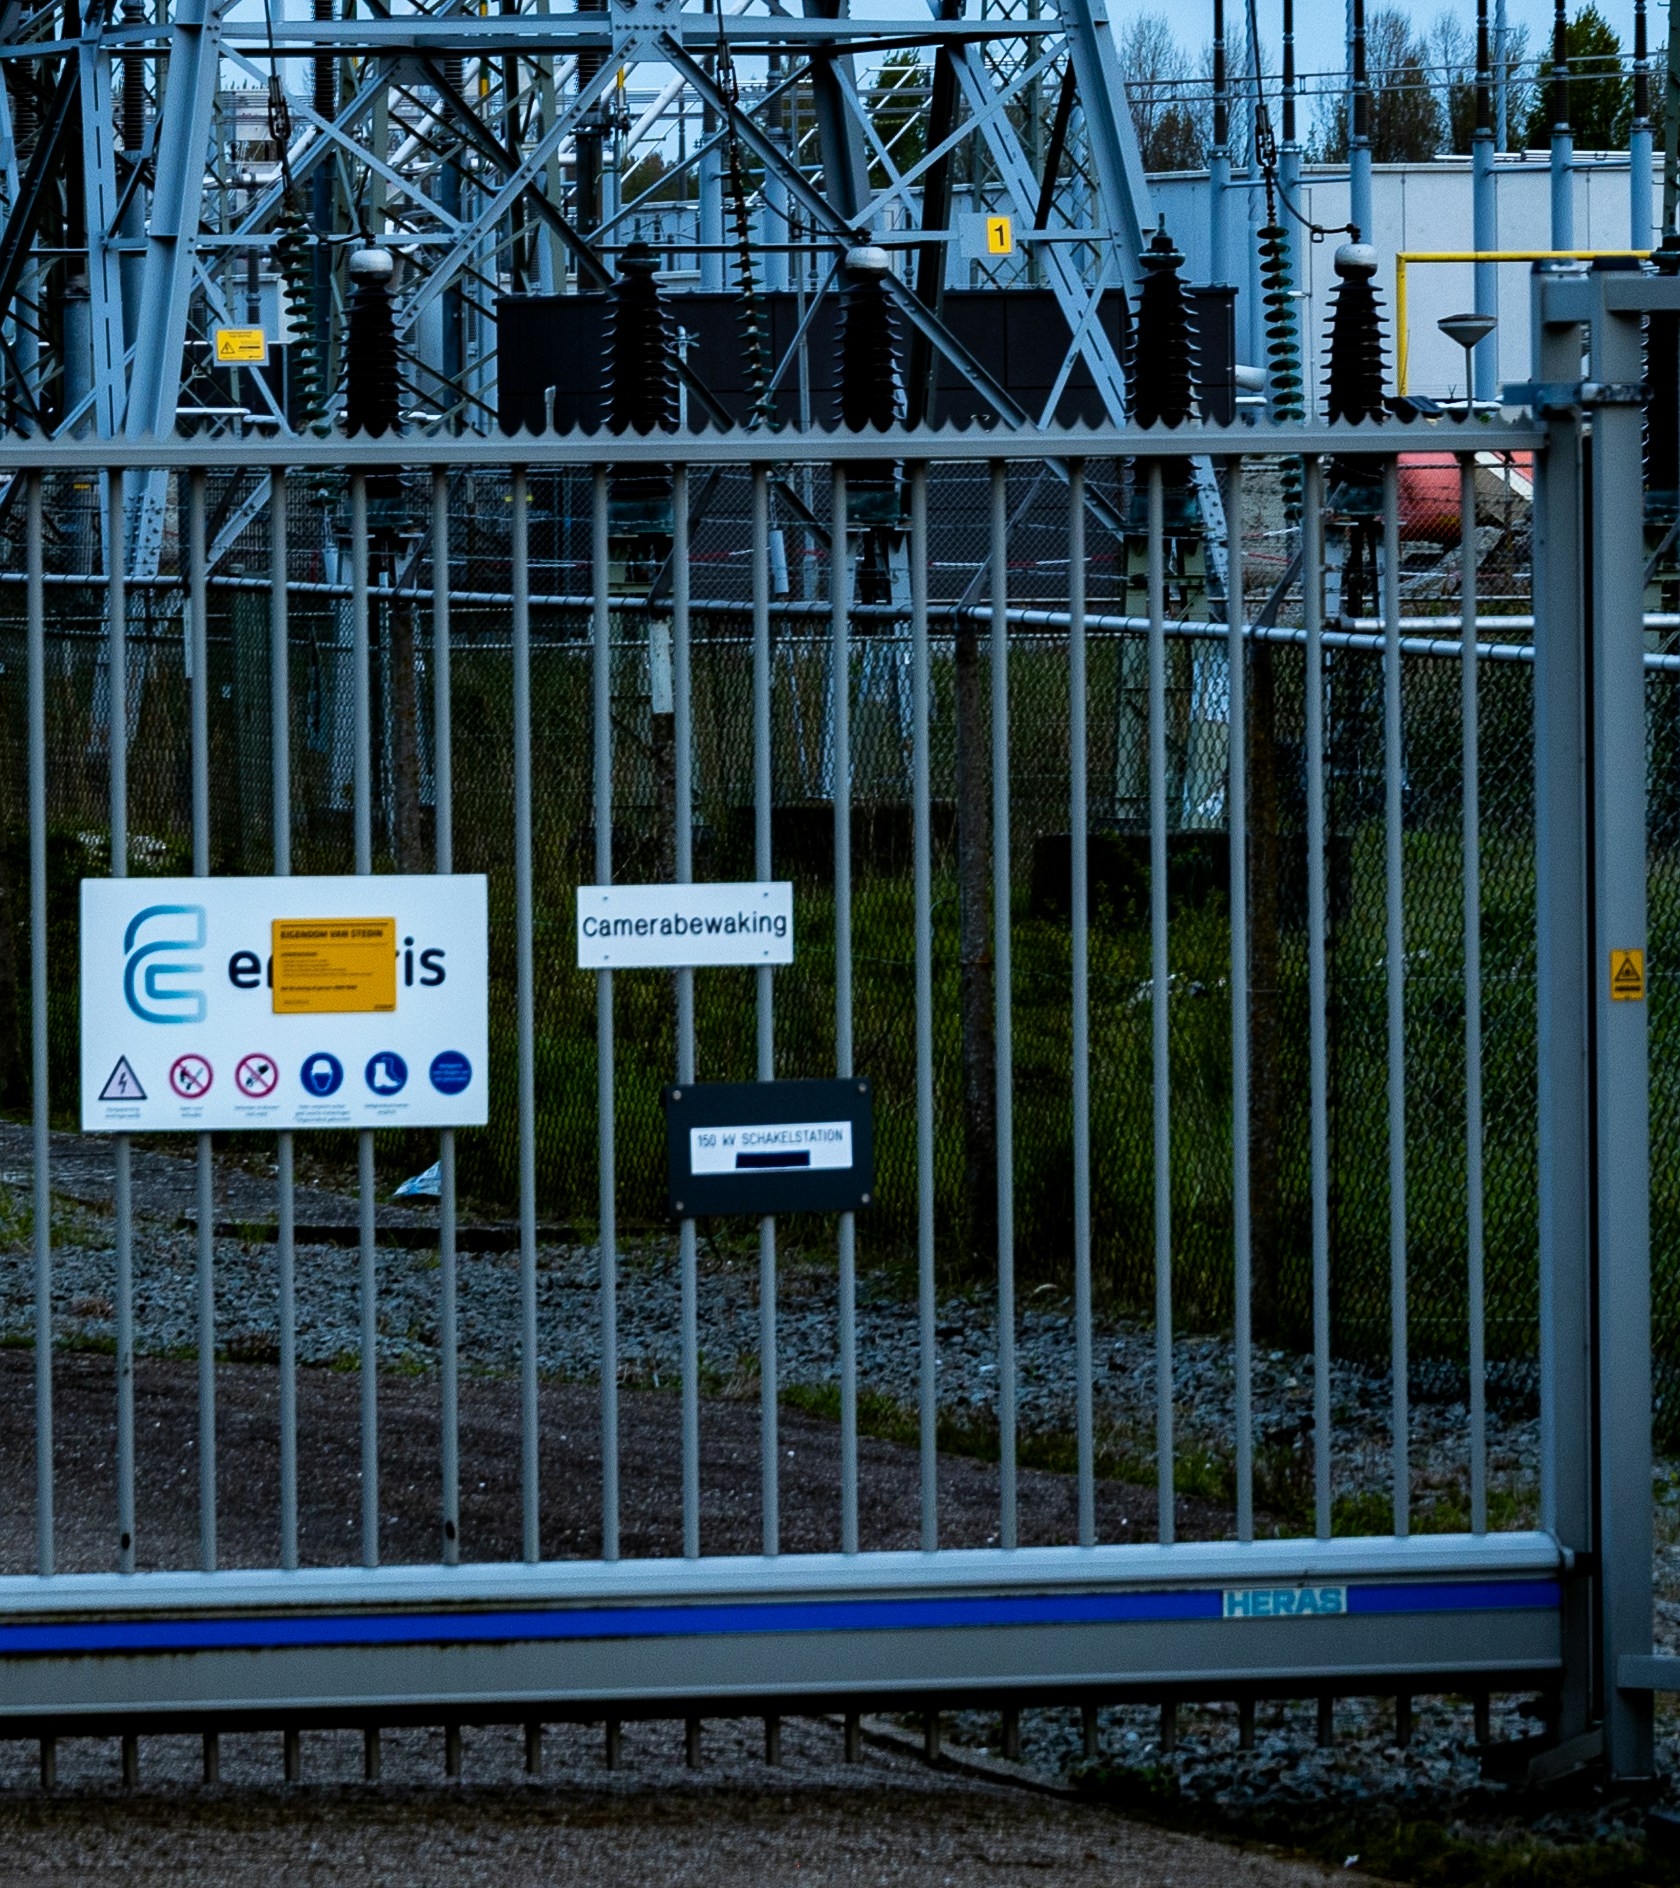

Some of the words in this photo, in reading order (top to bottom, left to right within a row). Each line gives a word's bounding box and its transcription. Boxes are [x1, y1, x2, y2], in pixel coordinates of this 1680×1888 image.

[994, 225, 1004, 246] 1
[582, 912, 787, 938] Camerabewaking
[741, 1128, 843, 1145] SCHAKELSTATION
[1225, 1586, 1344, 1614] HERAS
